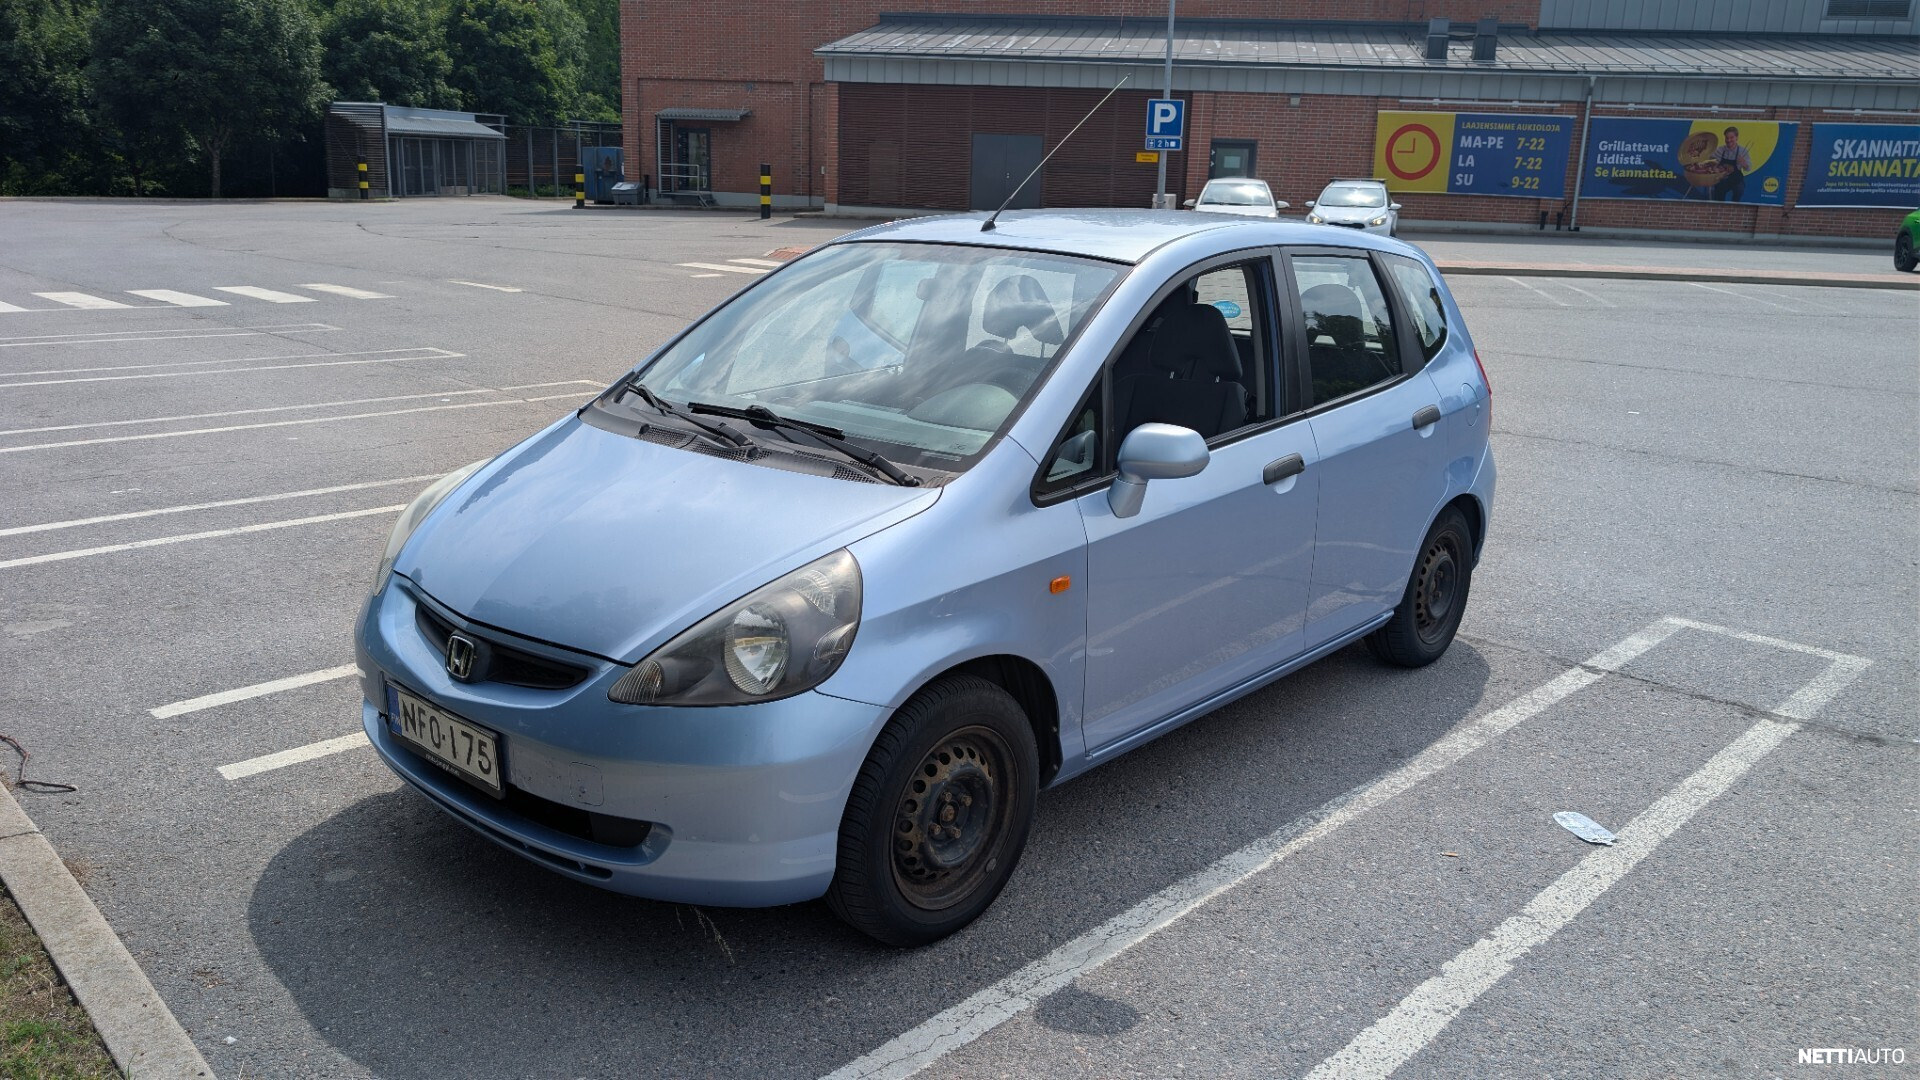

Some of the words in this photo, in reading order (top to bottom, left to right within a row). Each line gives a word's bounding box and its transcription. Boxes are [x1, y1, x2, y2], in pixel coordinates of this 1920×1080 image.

[1153, 103, 1177, 133] P
[1461, 122, 1516, 131] LAAJENSIMME
[1516, 124, 1560, 133] AUKIOLOJA
[1157, 140, 1163, 148] 2
[1164, 140, 1170, 148] h
[1460, 135, 1504, 149] MA-PE
[1517, 137, 1546, 150] 7-22
[1599, 140, 1669, 153] Grillattavat
[1458, 155, 1475, 167] LA
[1514, 157, 1543, 170] 7-22
[1596, 153, 1645, 165] Lidlistä.
[1594, 166, 1610, 178] Se
[1611, 167, 1677, 179] kannattaa.
[1455, 173, 1474, 186] SU
[1511, 176, 1539, 189] 9-22
[402, 699, 492, 775] NFO-175
